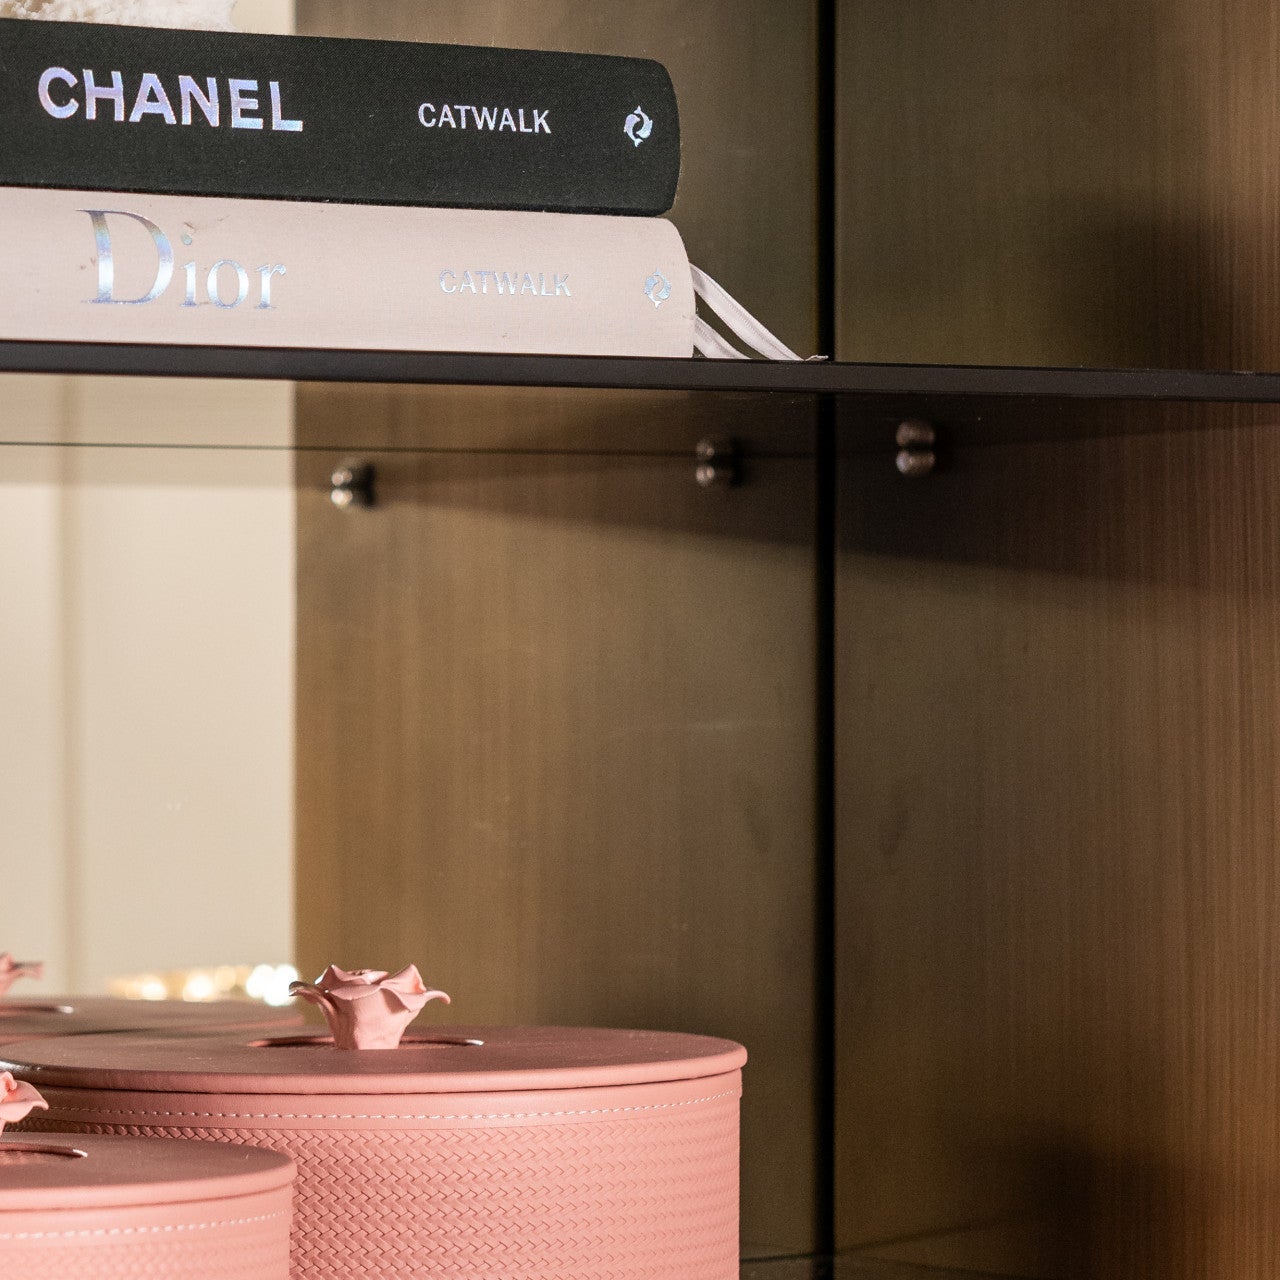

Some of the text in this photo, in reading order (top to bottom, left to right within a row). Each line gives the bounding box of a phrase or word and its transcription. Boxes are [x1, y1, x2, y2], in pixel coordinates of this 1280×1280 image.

[38, 66, 551, 133] CHANEL CATWALK
[75, 209, 571, 309] Dior CATWALK
